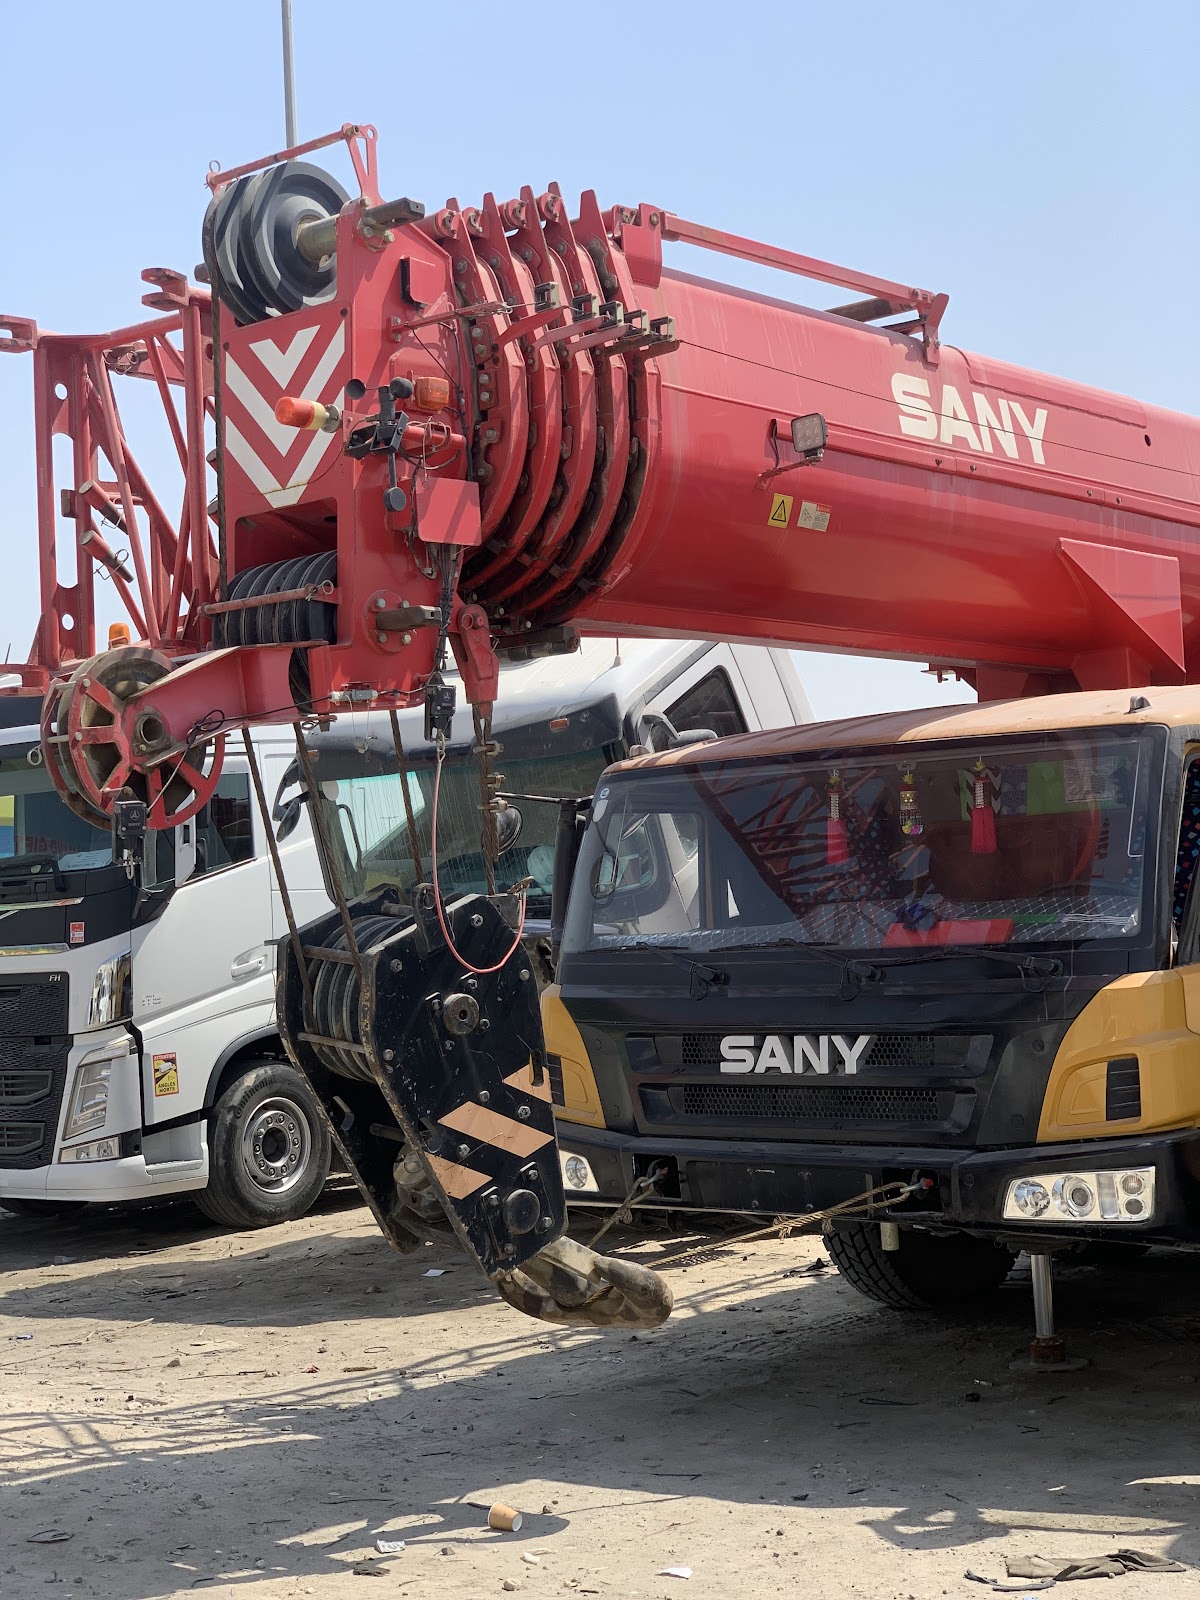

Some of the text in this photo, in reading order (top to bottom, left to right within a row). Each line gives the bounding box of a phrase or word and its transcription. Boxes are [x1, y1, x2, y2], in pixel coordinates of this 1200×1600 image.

[891, 372, 1048, 465] SANY
[49, 974, 61, 982] FH
[153, 1053, 176, 1061] ATTENTION
[719, 1034, 871, 1075] SANY
